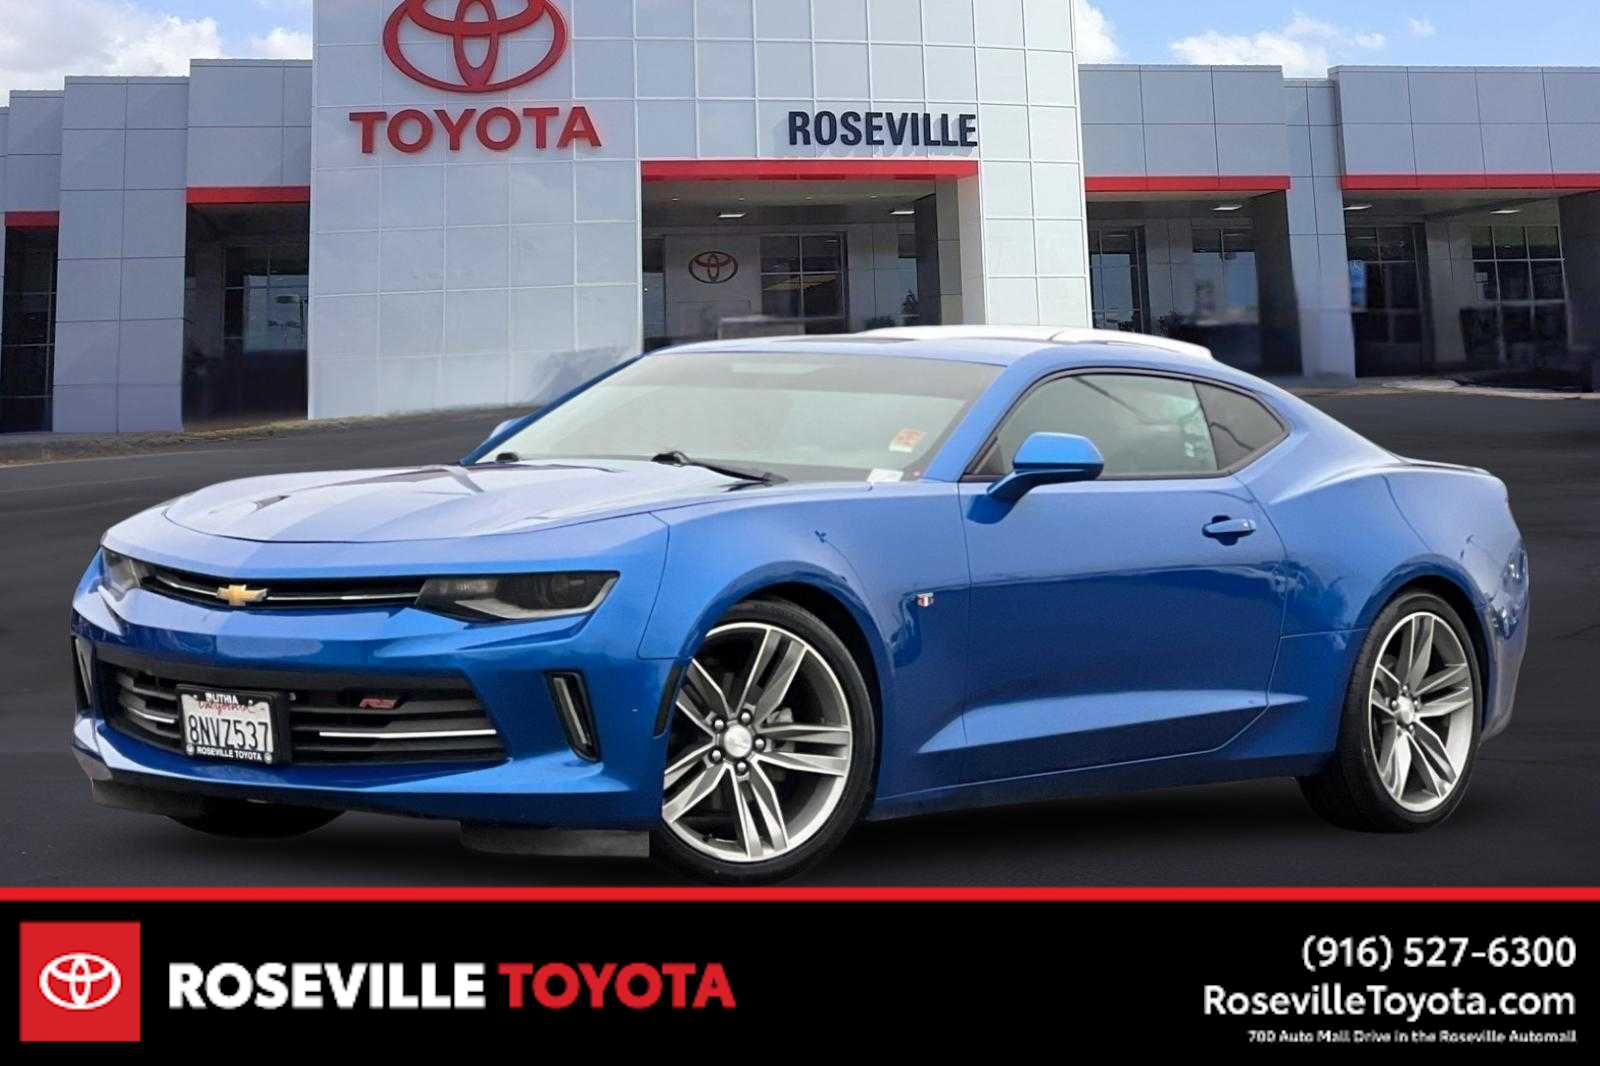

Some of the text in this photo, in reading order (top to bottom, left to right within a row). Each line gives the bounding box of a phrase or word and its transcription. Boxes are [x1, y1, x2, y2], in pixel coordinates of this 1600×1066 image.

[349, 106, 602, 153] TOYOTA
[788, 111, 978, 147] ROSEVILLE
[187, 713, 270, 753] 8NVZ537
[196, 745, 263, 762] ROSEVILLE TOYOTA
